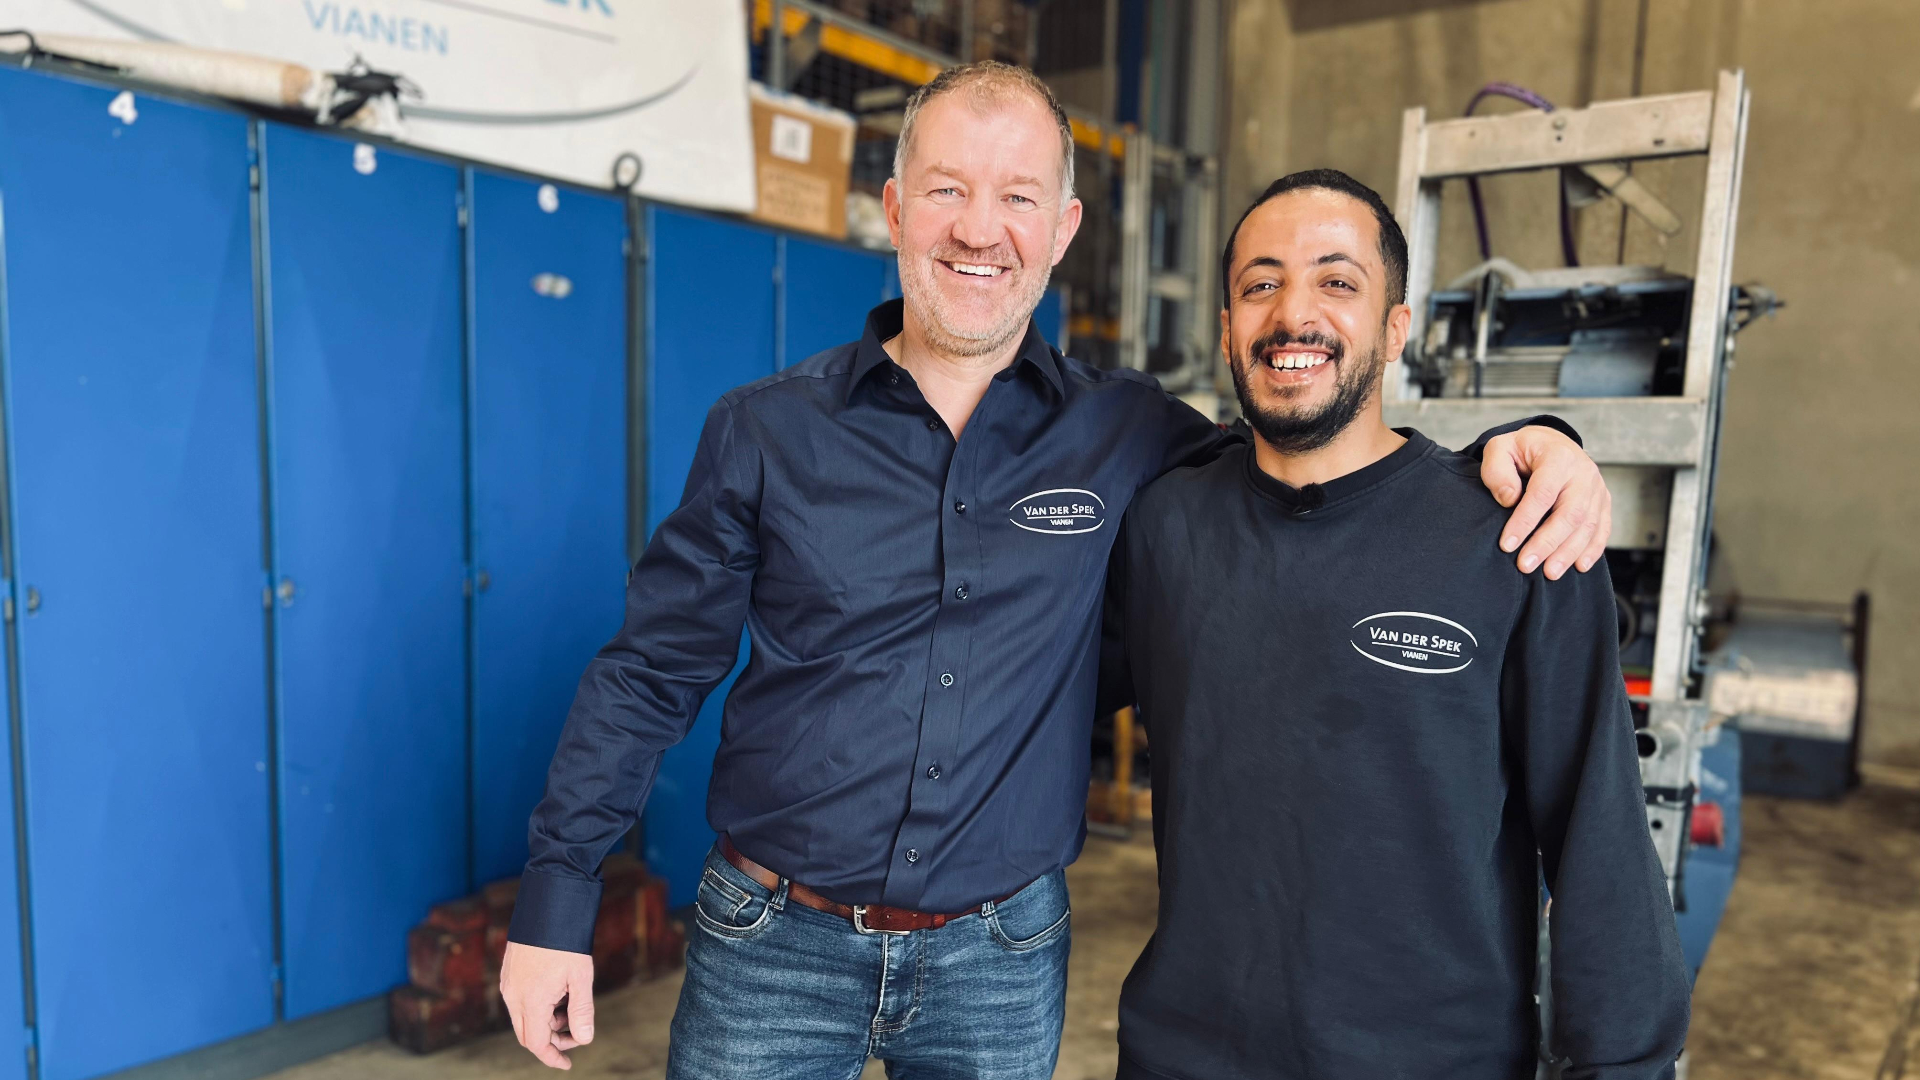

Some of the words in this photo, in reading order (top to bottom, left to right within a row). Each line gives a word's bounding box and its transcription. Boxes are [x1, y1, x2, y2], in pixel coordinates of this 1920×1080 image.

[302, 0, 450, 55] VIANEN
[108, 91, 138, 125] 4
[1023, 505, 1047, 516] VAN
[1049, 506, 1069, 515] DER
[1071, 503, 1095, 515] SPEK
[1369, 626, 1399, 642] VAN
[1402, 632, 1428, 646] DER
[1430, 635, 1462, 653] SPEK
[1401, 650, 1429, 661] VIANEN
